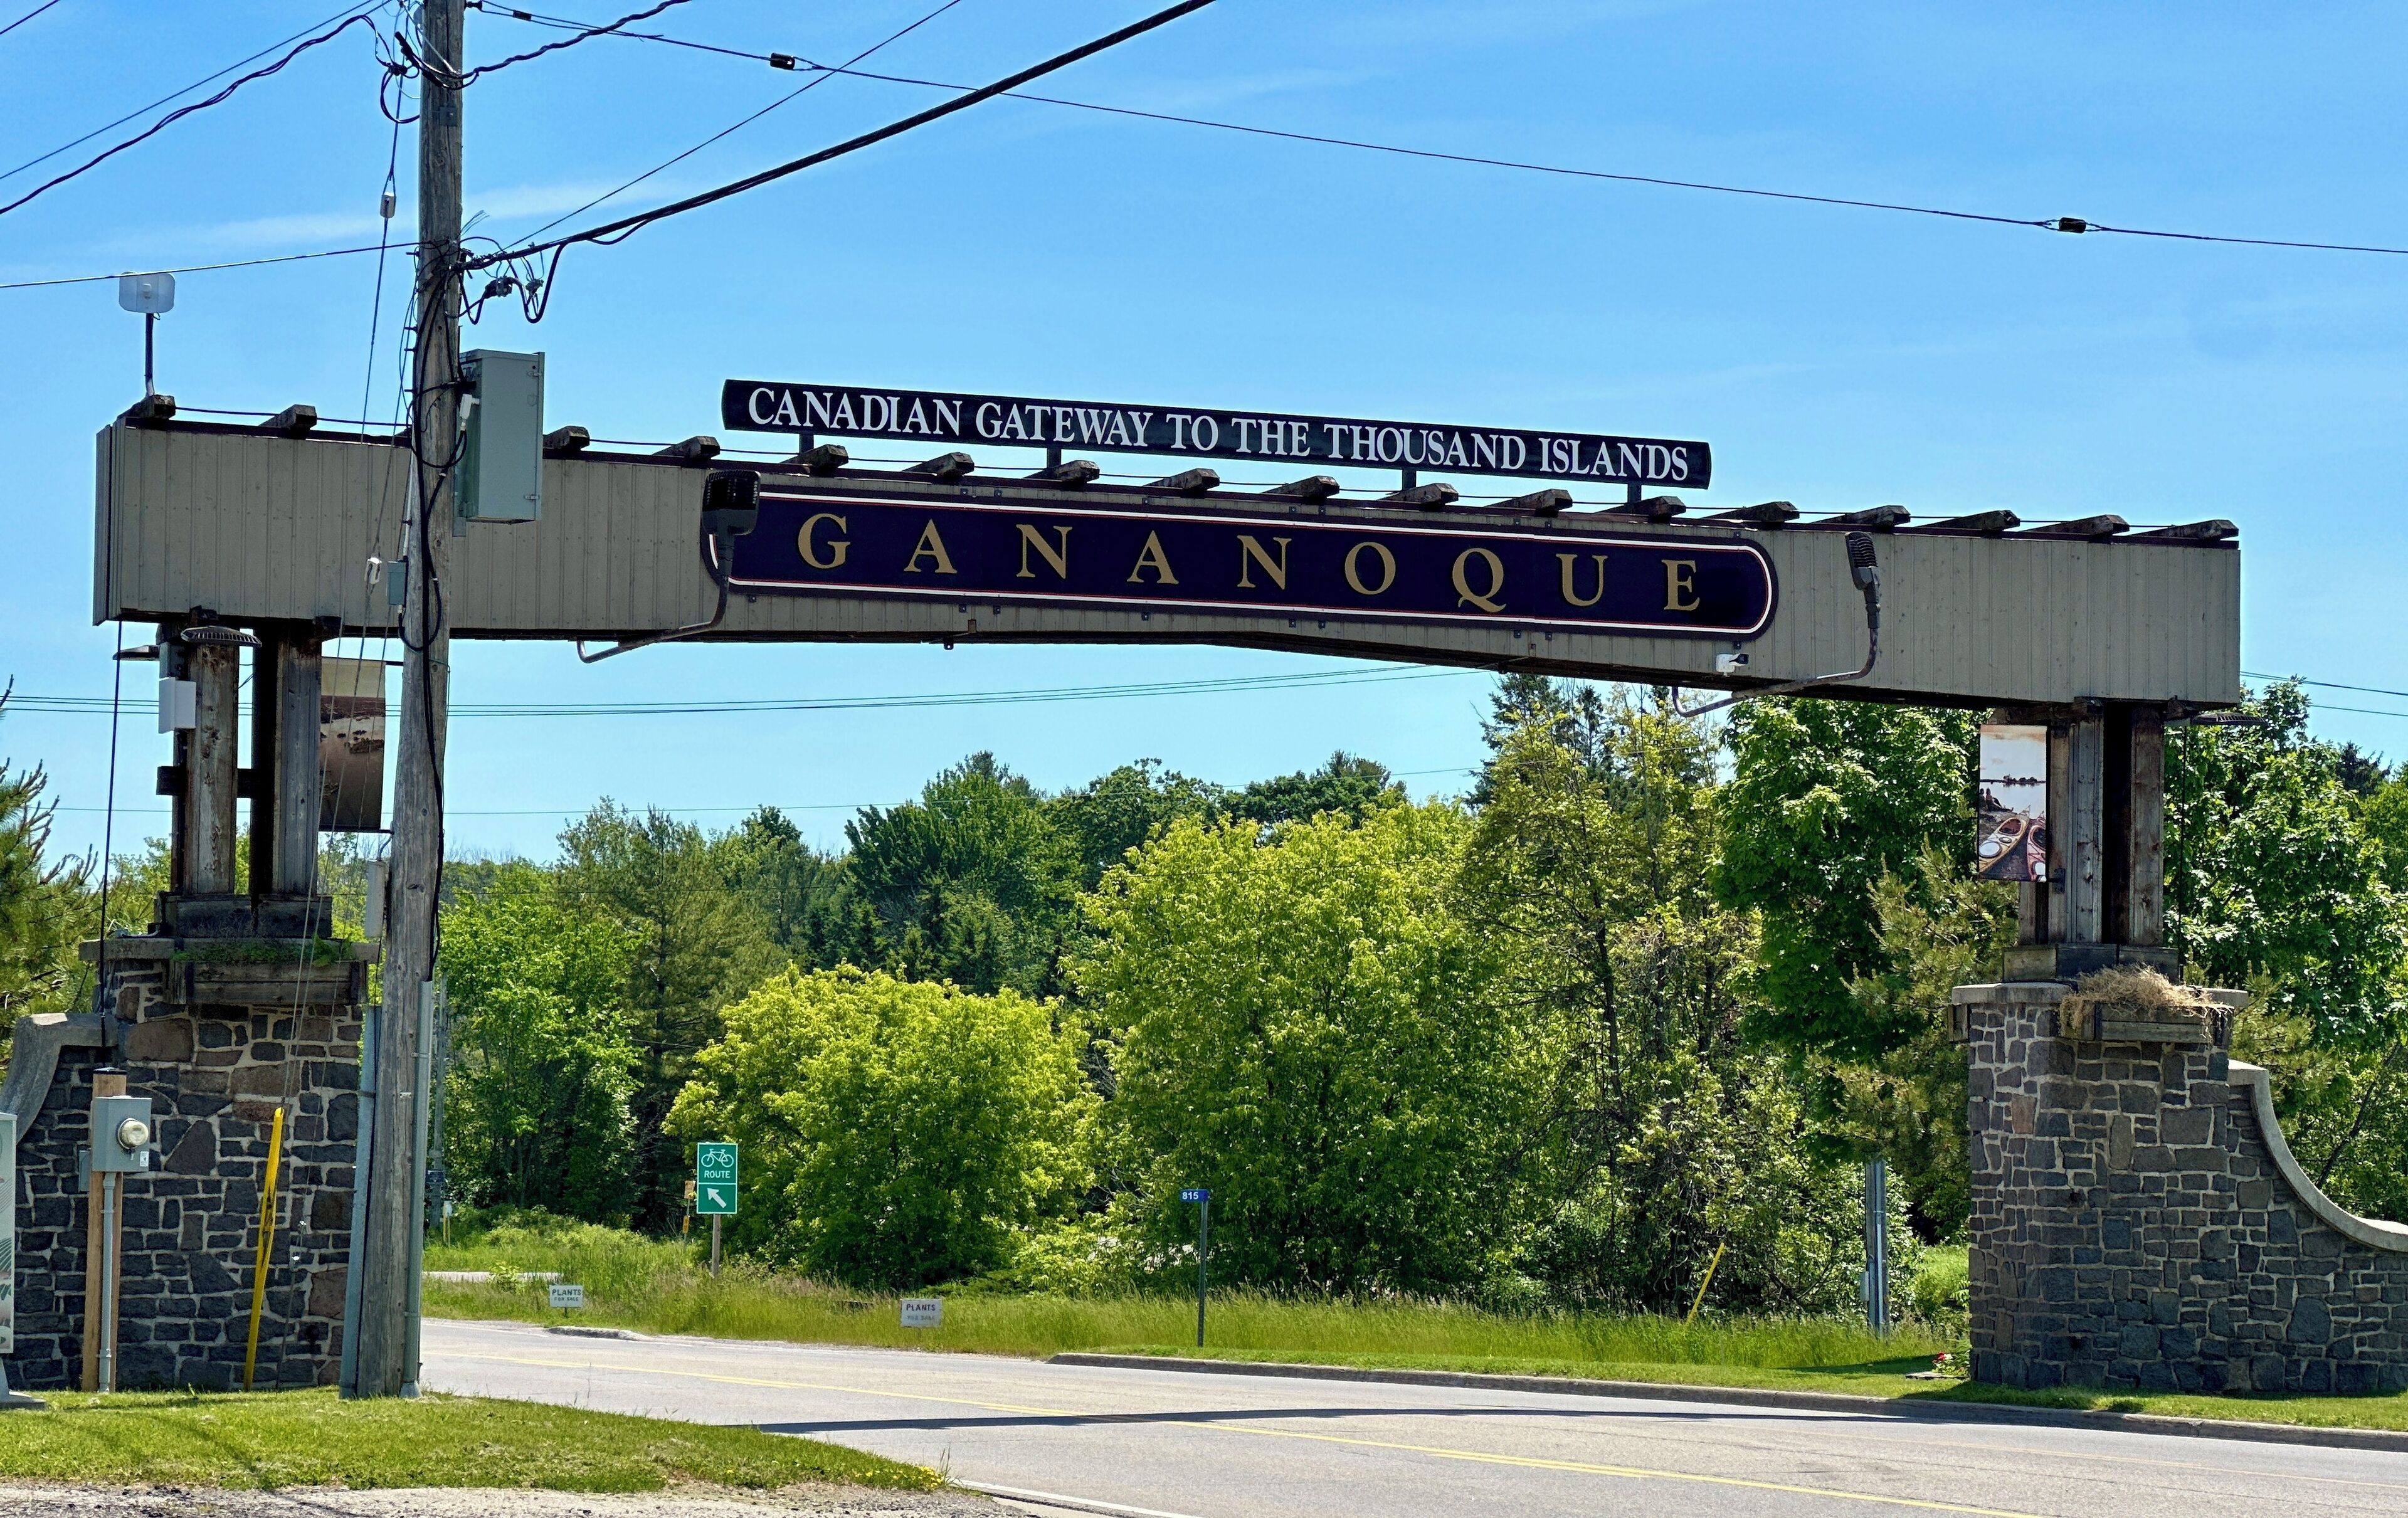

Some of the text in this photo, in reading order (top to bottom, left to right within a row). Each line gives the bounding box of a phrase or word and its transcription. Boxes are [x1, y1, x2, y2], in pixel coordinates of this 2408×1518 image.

[749, 387, 1689, 482] CANADIAN GATEWAY TO THE THOUSAND ISLANDS
[798, 512, 1701, 613] GANANOQUE
[704, 1170, 731, 1178] ROUTE
[1182, 1191, 1199, 1200] 815
